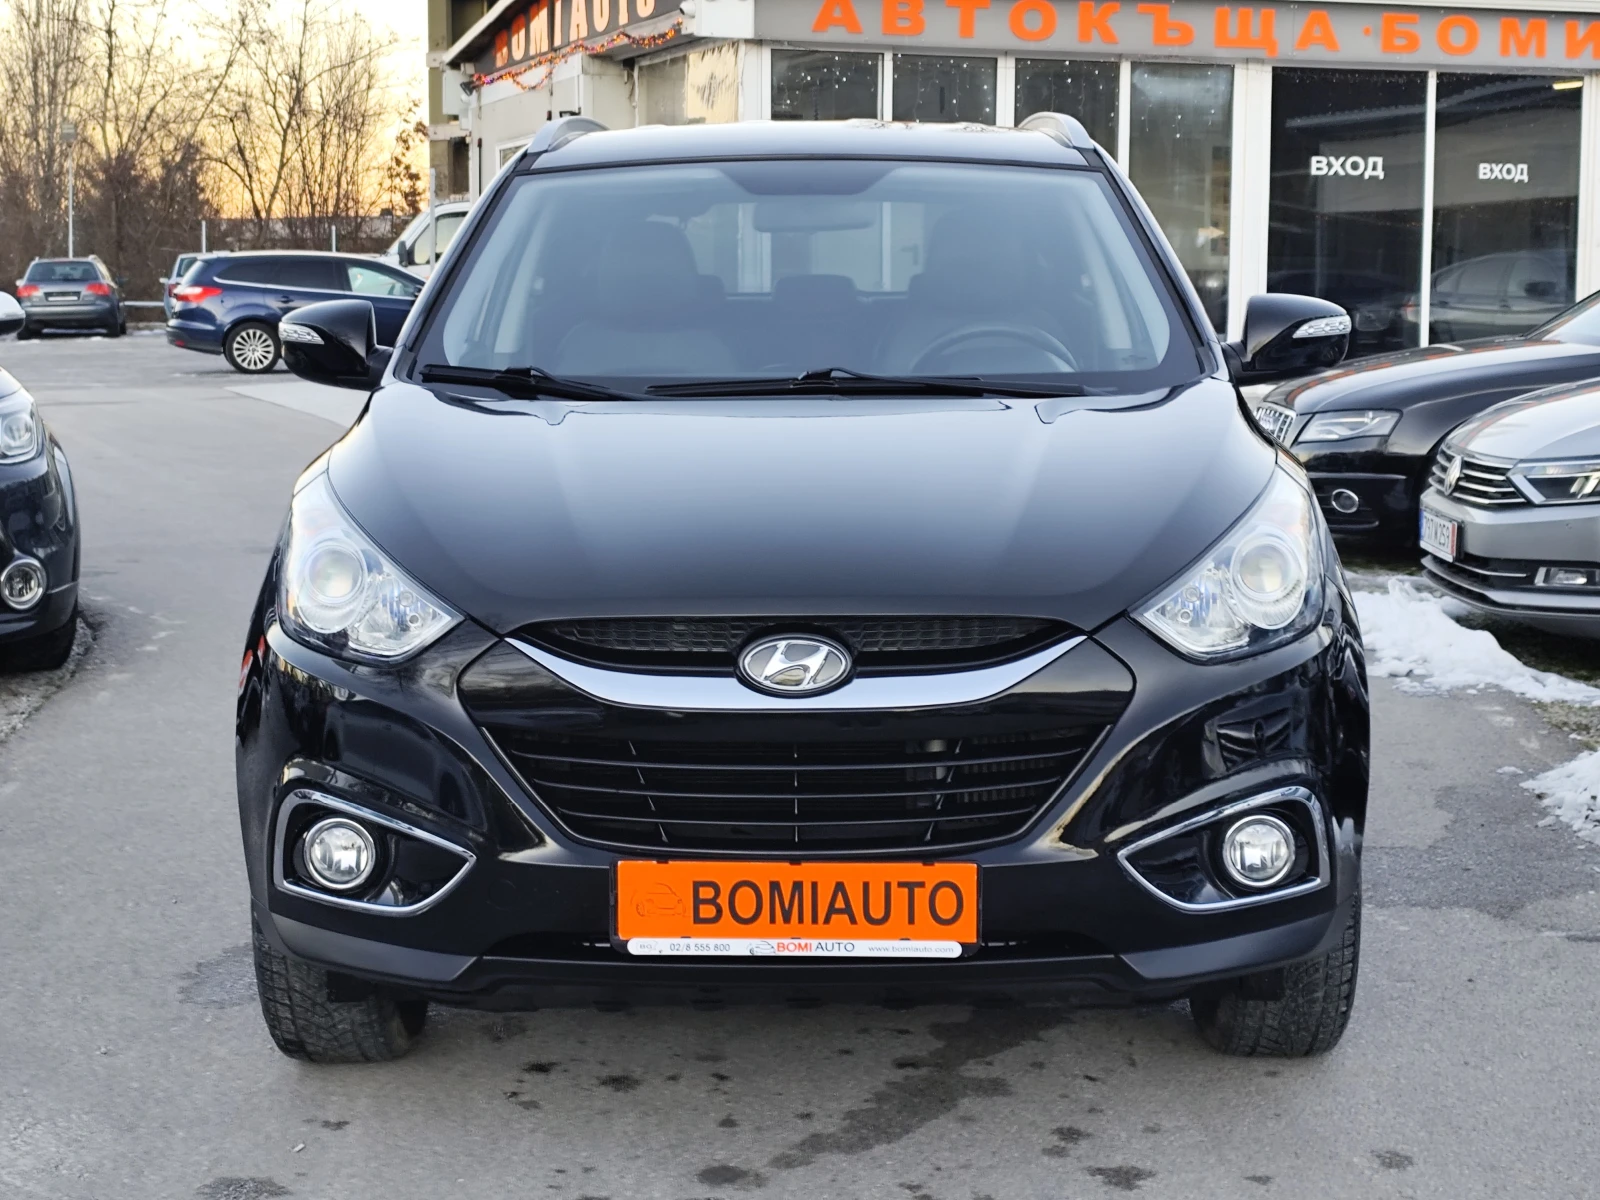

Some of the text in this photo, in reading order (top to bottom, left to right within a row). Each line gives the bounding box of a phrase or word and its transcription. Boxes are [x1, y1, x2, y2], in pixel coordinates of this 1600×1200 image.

[811, 0, 1600, 59] АВТОКЪЩА БОМИ
[1310, 156, 1384, 180] ВХОД
[1478, 163, 1529, 183] ВХОД
[691, 880, 965, 926] BOMIAUTO
[694, 942, 711, 952] 555
[713, 943, 731, 952] 800
[776, 942, 855, 953] BOMI AUTO
[867, 944, 954, 954] www.bomiauto.com
